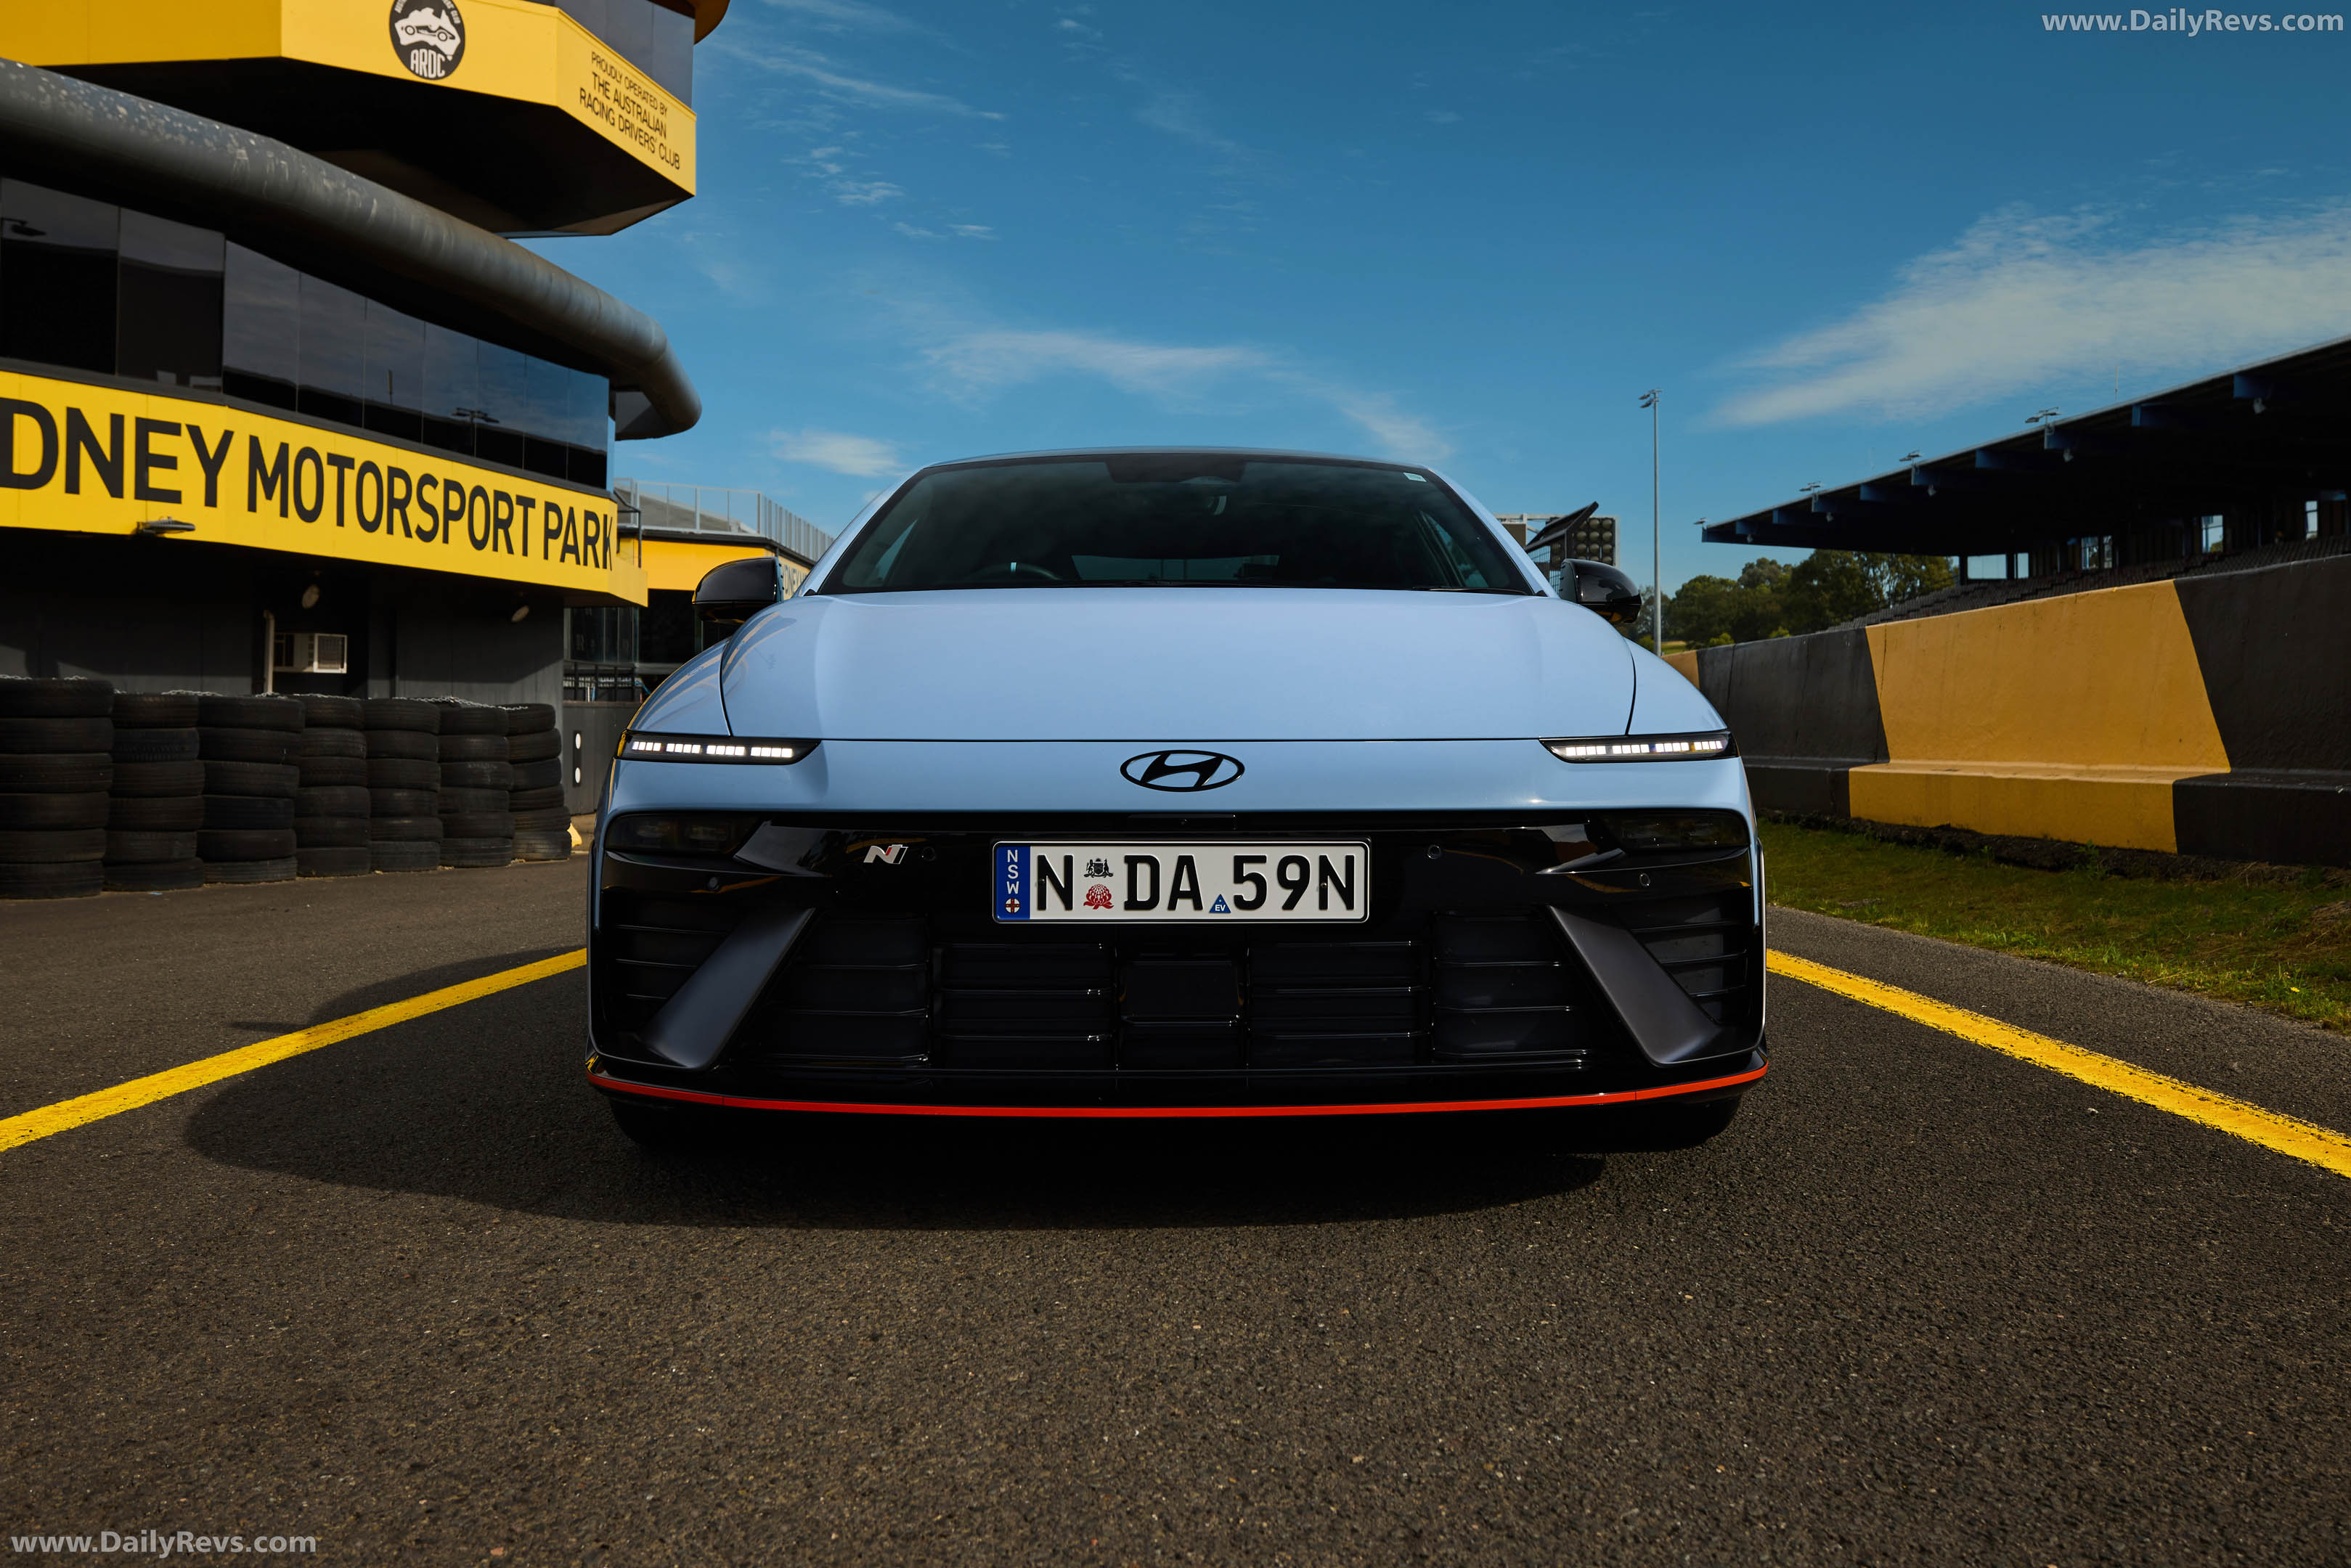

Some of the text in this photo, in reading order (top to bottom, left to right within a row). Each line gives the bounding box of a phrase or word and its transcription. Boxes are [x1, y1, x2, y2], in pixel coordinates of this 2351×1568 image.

[410, 48, 446, 78] ARDC
[591, 51, 667, 117] PROUDLY OPERATED BY
[579, 86, 680, 170] RACING DRIVERS' CLUB
[592, 72, 667, 139] THE AUSTRALIAN
[0, 397, 613, 571] DNEY MOTORSPORT PARK
[1006, 849, 1019, 894] NSW
